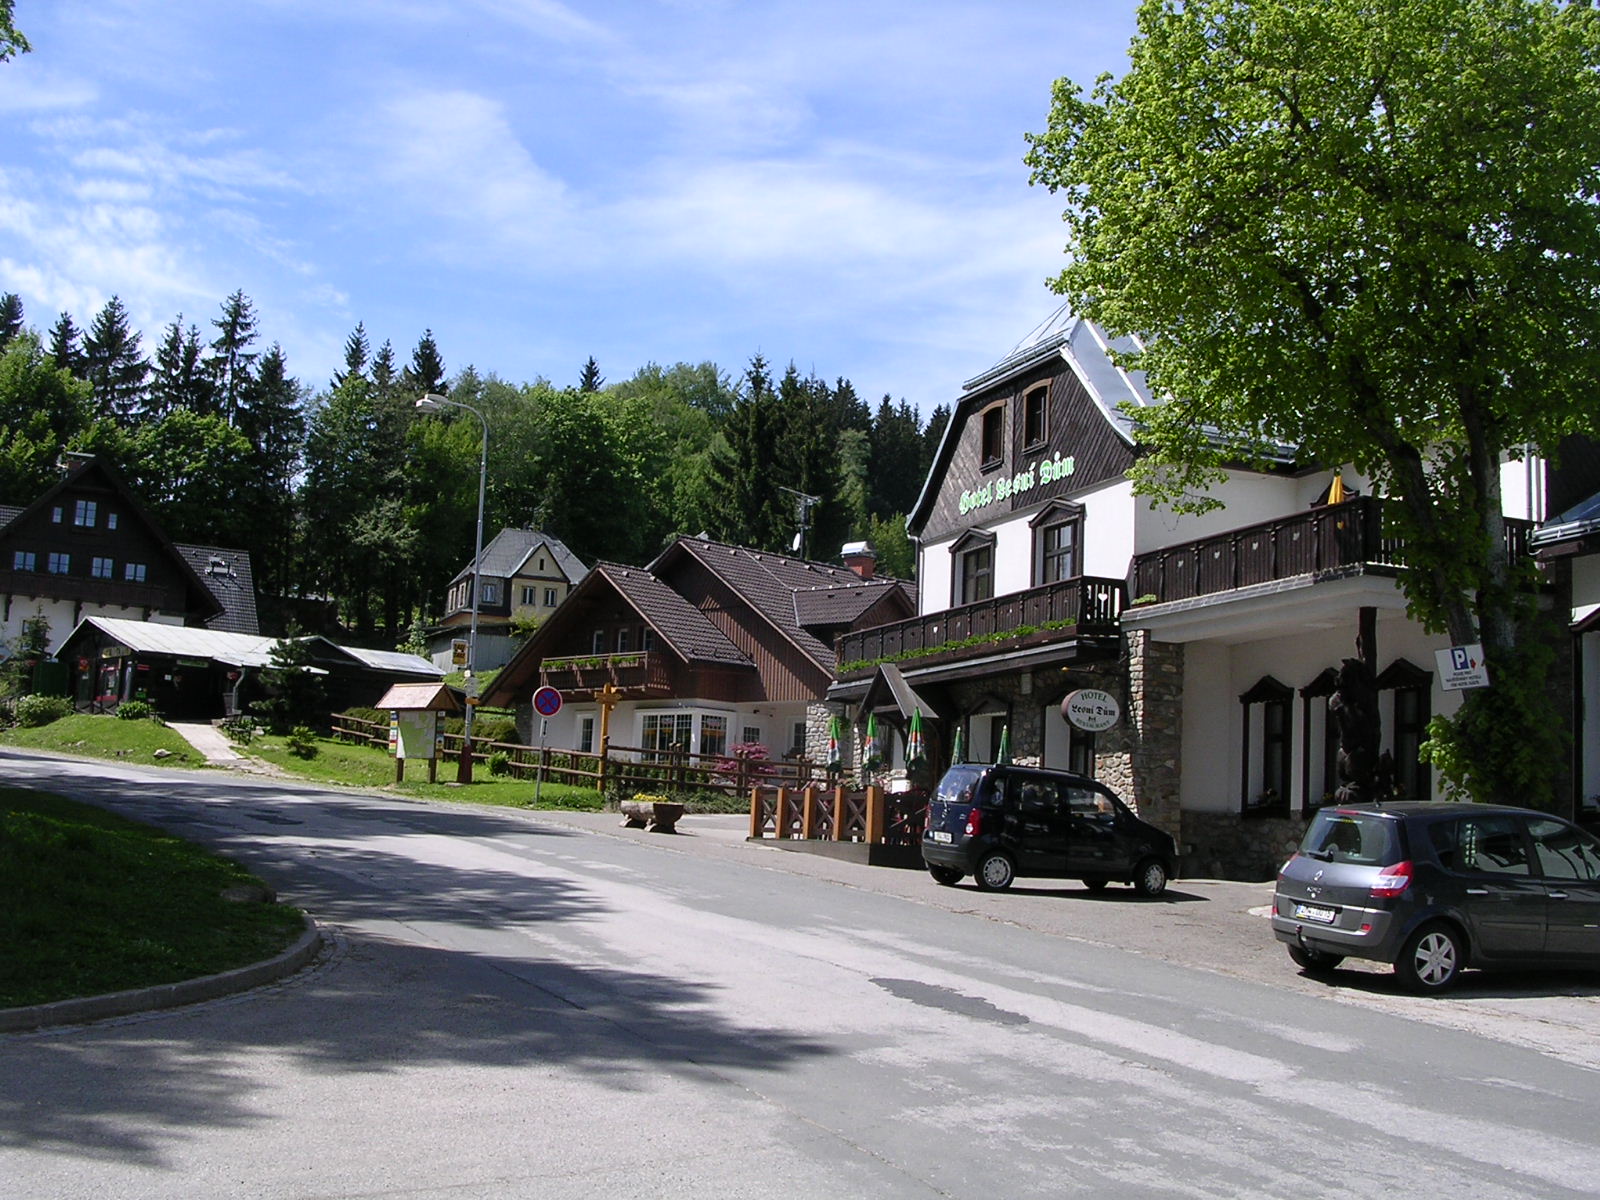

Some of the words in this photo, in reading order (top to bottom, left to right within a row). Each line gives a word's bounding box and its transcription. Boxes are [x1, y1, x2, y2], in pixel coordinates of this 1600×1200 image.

[959, 479, 993, 515] Hotel
[995, 462, 1036, 502] Lesní
[1039, 451, 1075, 485] Dům
[1454, 649, 1466, 669] P
[1080, 691, 1107, 702] HOTEL
